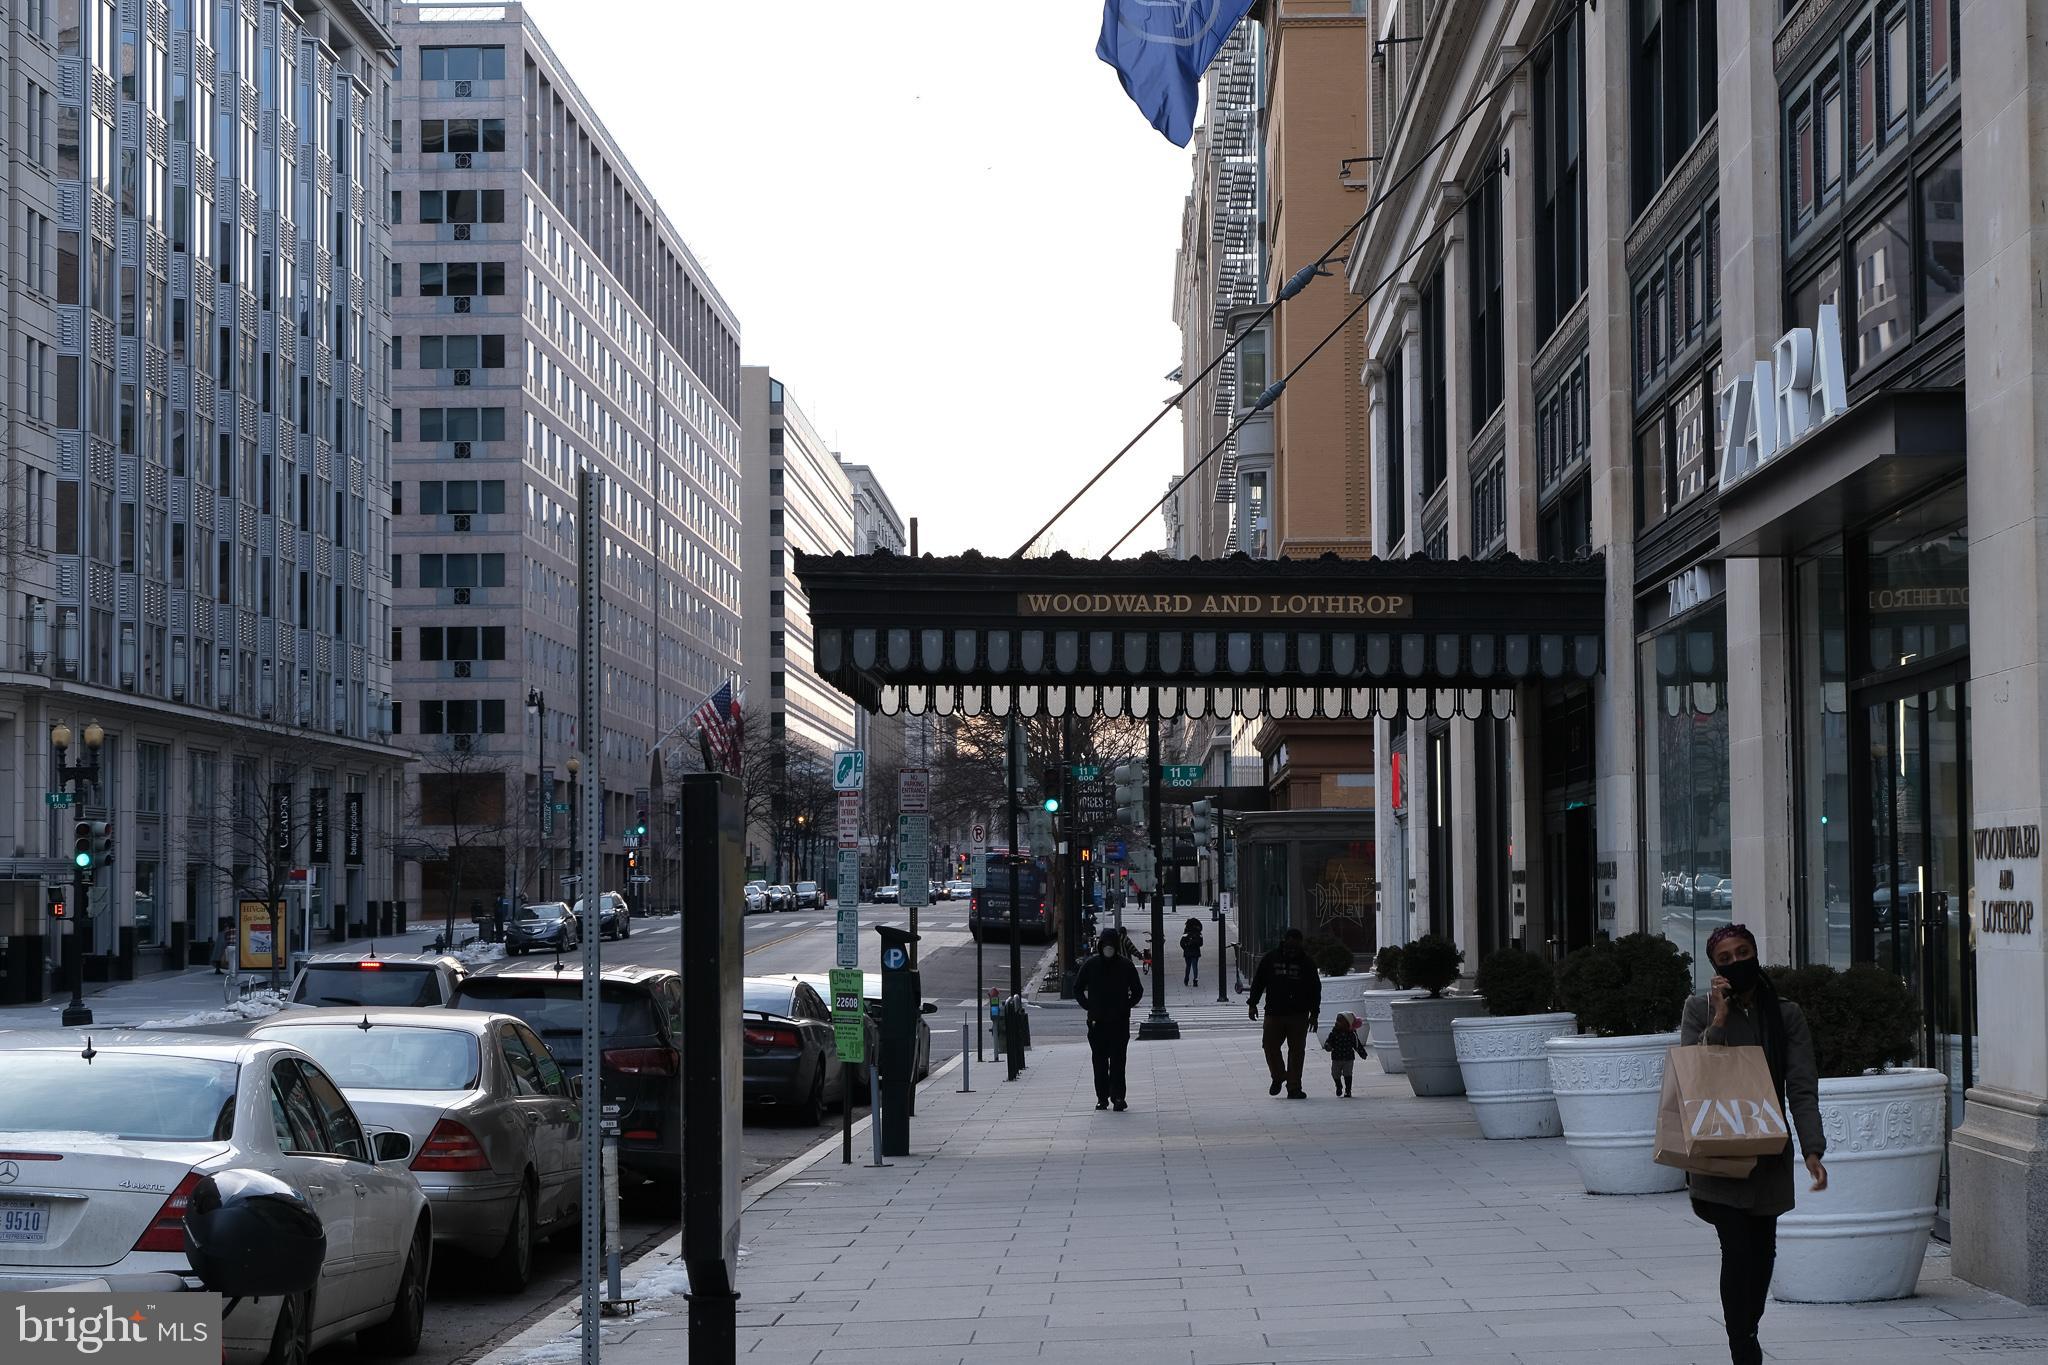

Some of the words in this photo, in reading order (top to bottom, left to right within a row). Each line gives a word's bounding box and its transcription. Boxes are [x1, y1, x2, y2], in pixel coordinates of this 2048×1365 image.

[1718, 304, 1848, 493] ZARA
[1027, 594, 1193, 613] WOODWARD
[1201, 594, 1262, 614] AND
[1270, 595, 1404, 615] LOTHROP
[856, 753, 862, 767] 2
[1170, 767, 1181, 778] 11
[1172, 779, 1192, 787] 600
[51, 794, 59, 802] 11
[350, 801, 359, 831] products
[350, 832, 359, 856] beauty
[1974, 825, 2040, 860] WOODWARD
[1999, 869, 2015, 890] AND
[54, 904, 62, 915] 13
[1315, 882, 1368, 918] PRET
[1981, 900, 2034, 934] LOTHROP
[836, 997, 858, 1008] 22608
[1684, 1098, 1788, 1136] ZARA
[5, 1211, 40, 1231] 9510
